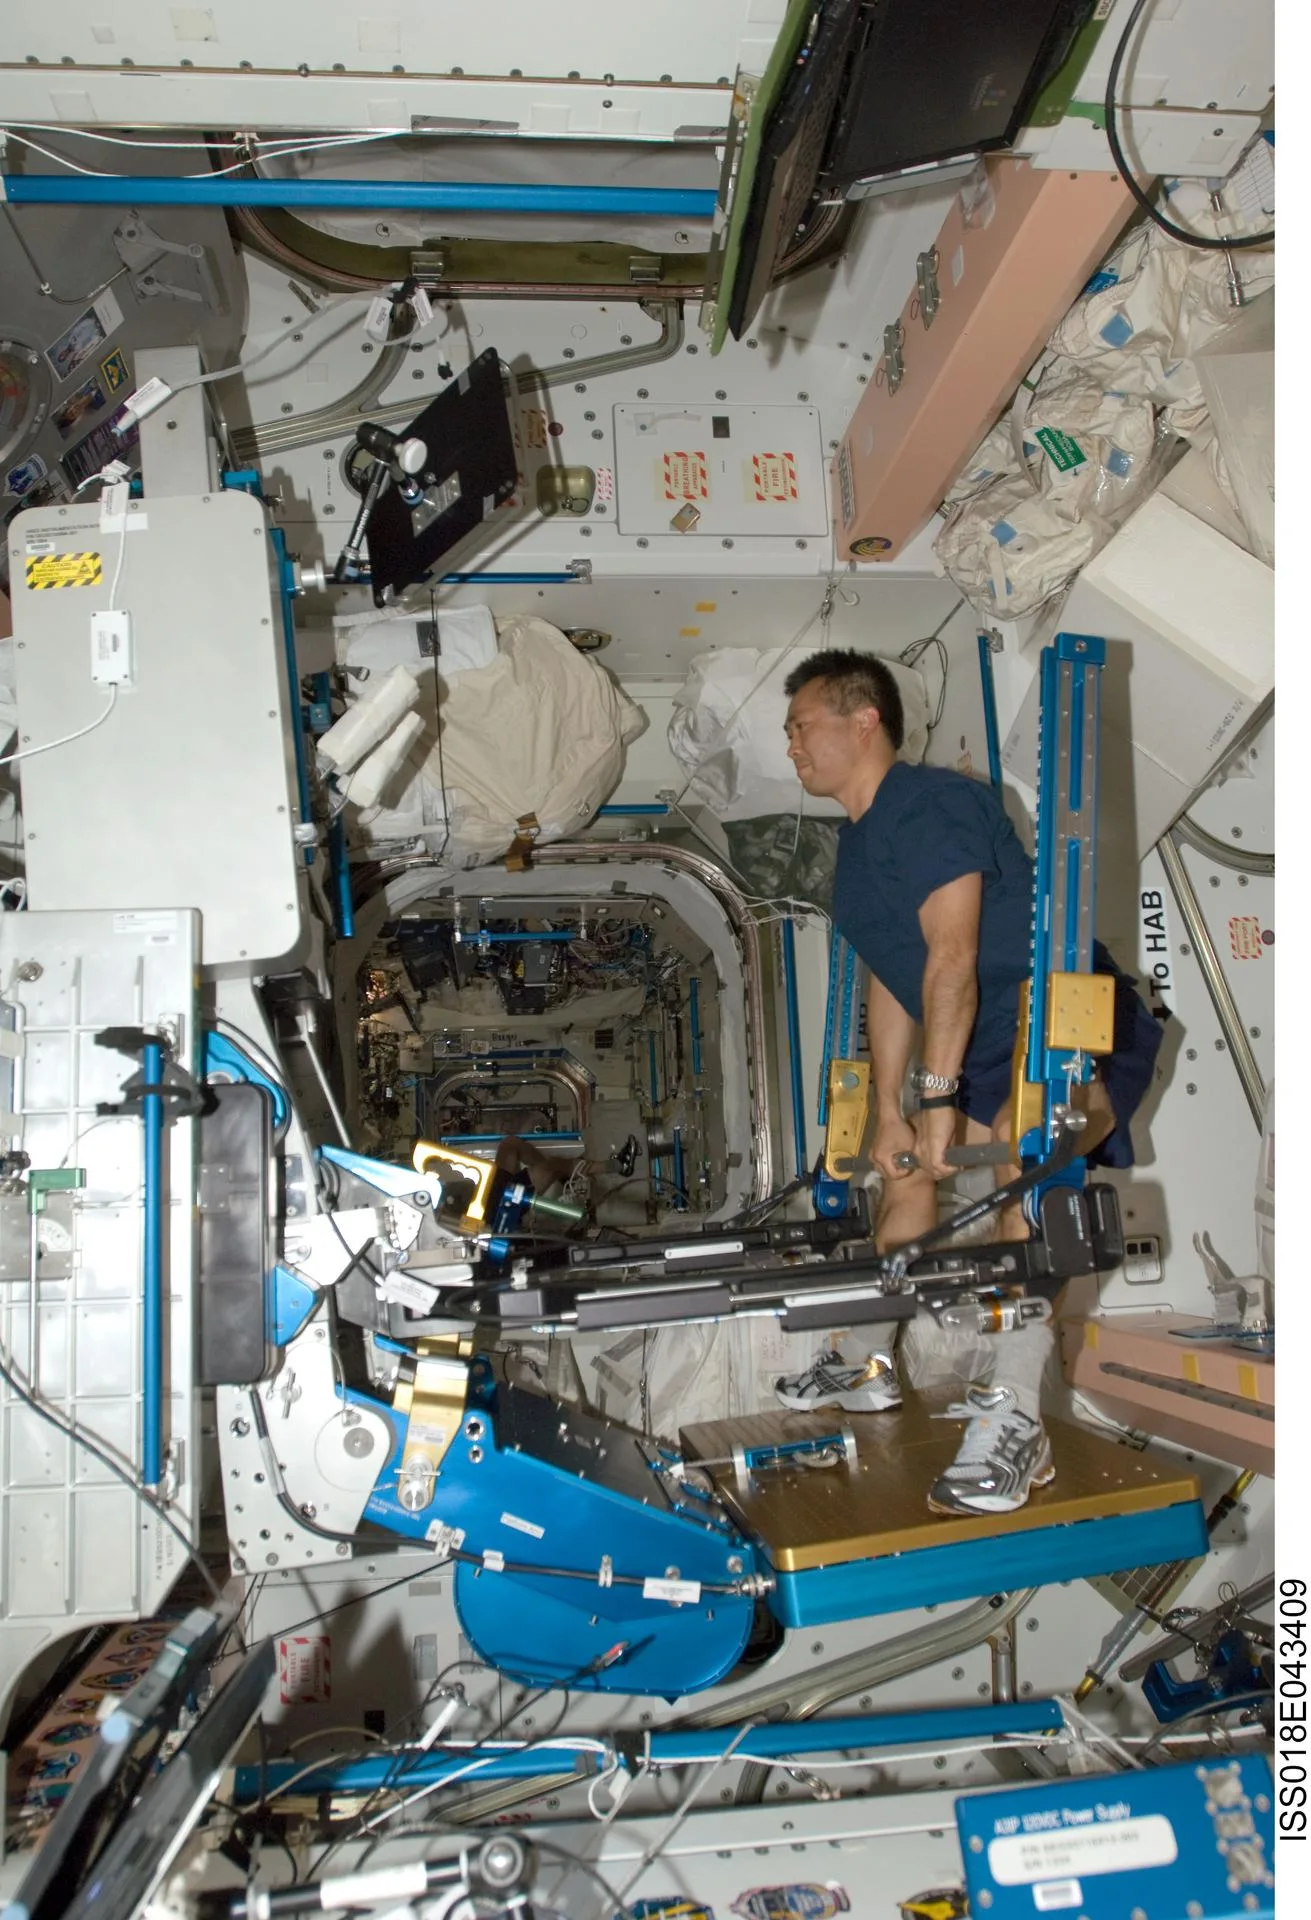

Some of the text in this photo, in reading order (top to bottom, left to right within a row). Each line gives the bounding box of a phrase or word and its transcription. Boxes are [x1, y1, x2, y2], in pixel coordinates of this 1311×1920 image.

[1041, 432, 1067, 468] TECHNICAL
[682, 456, 690, 496] BREATHING
[771, 468, 780, 487] FIRE
[1141, 891, 1171, 997] To HAB
[300, 1658, 310, 1682] FIRE
[1062, 1807, 1095, 1826] Power
[1095, 1800, 1131, 1822] Supply
